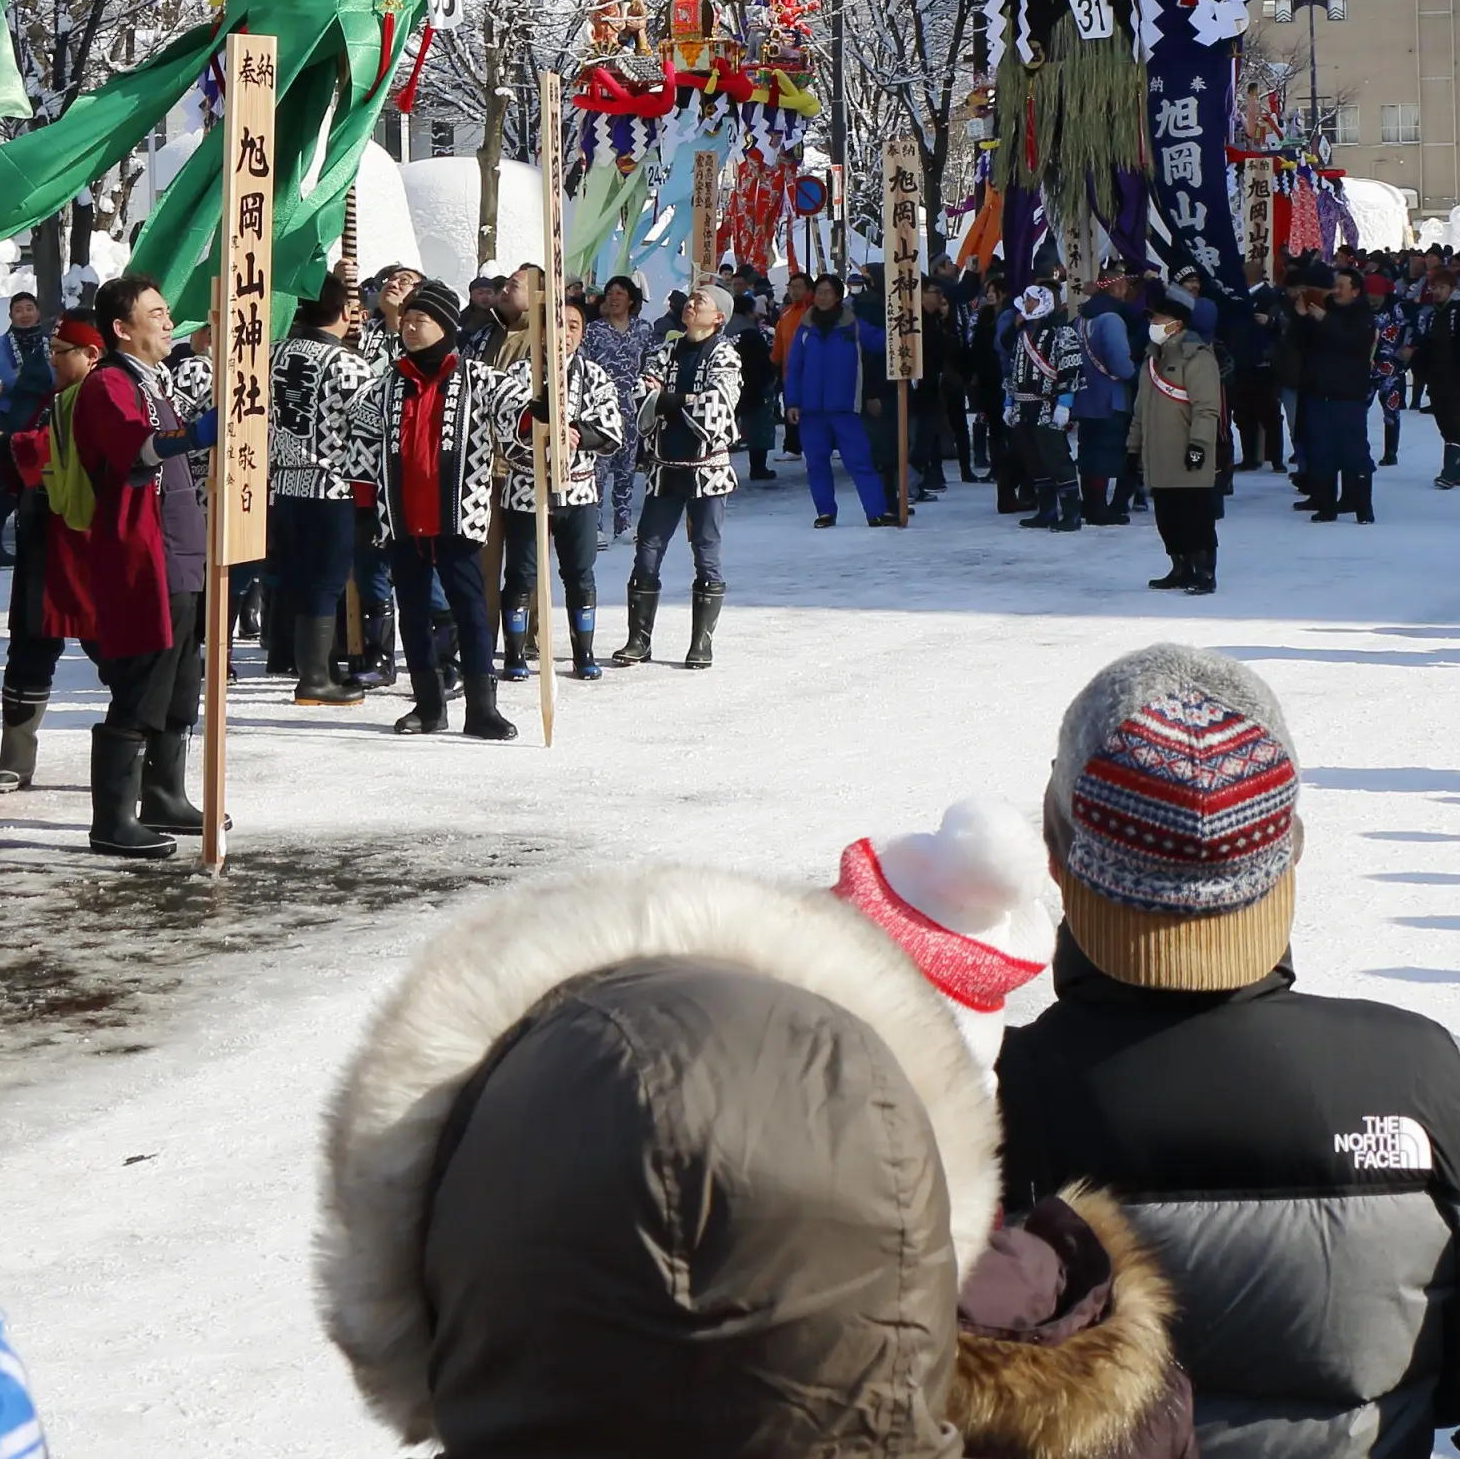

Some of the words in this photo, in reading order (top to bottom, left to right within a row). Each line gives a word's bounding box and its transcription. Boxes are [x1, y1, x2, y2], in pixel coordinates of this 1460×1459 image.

[236, 48, 274, 93] 奉納
[1155, 95, 1224, 285] 旭岡山神
[230, 126, 270, 424] 旭岡山神社
[888, 165, 922, 338] 旭岡山神社
[237, 442, 258, 514] 敬白
[1334, 1133, 1400, 1153] NORTH
[1362, 1116, 1400, 1134] THE
[1354, 1150, 1401, 1169] FACE
